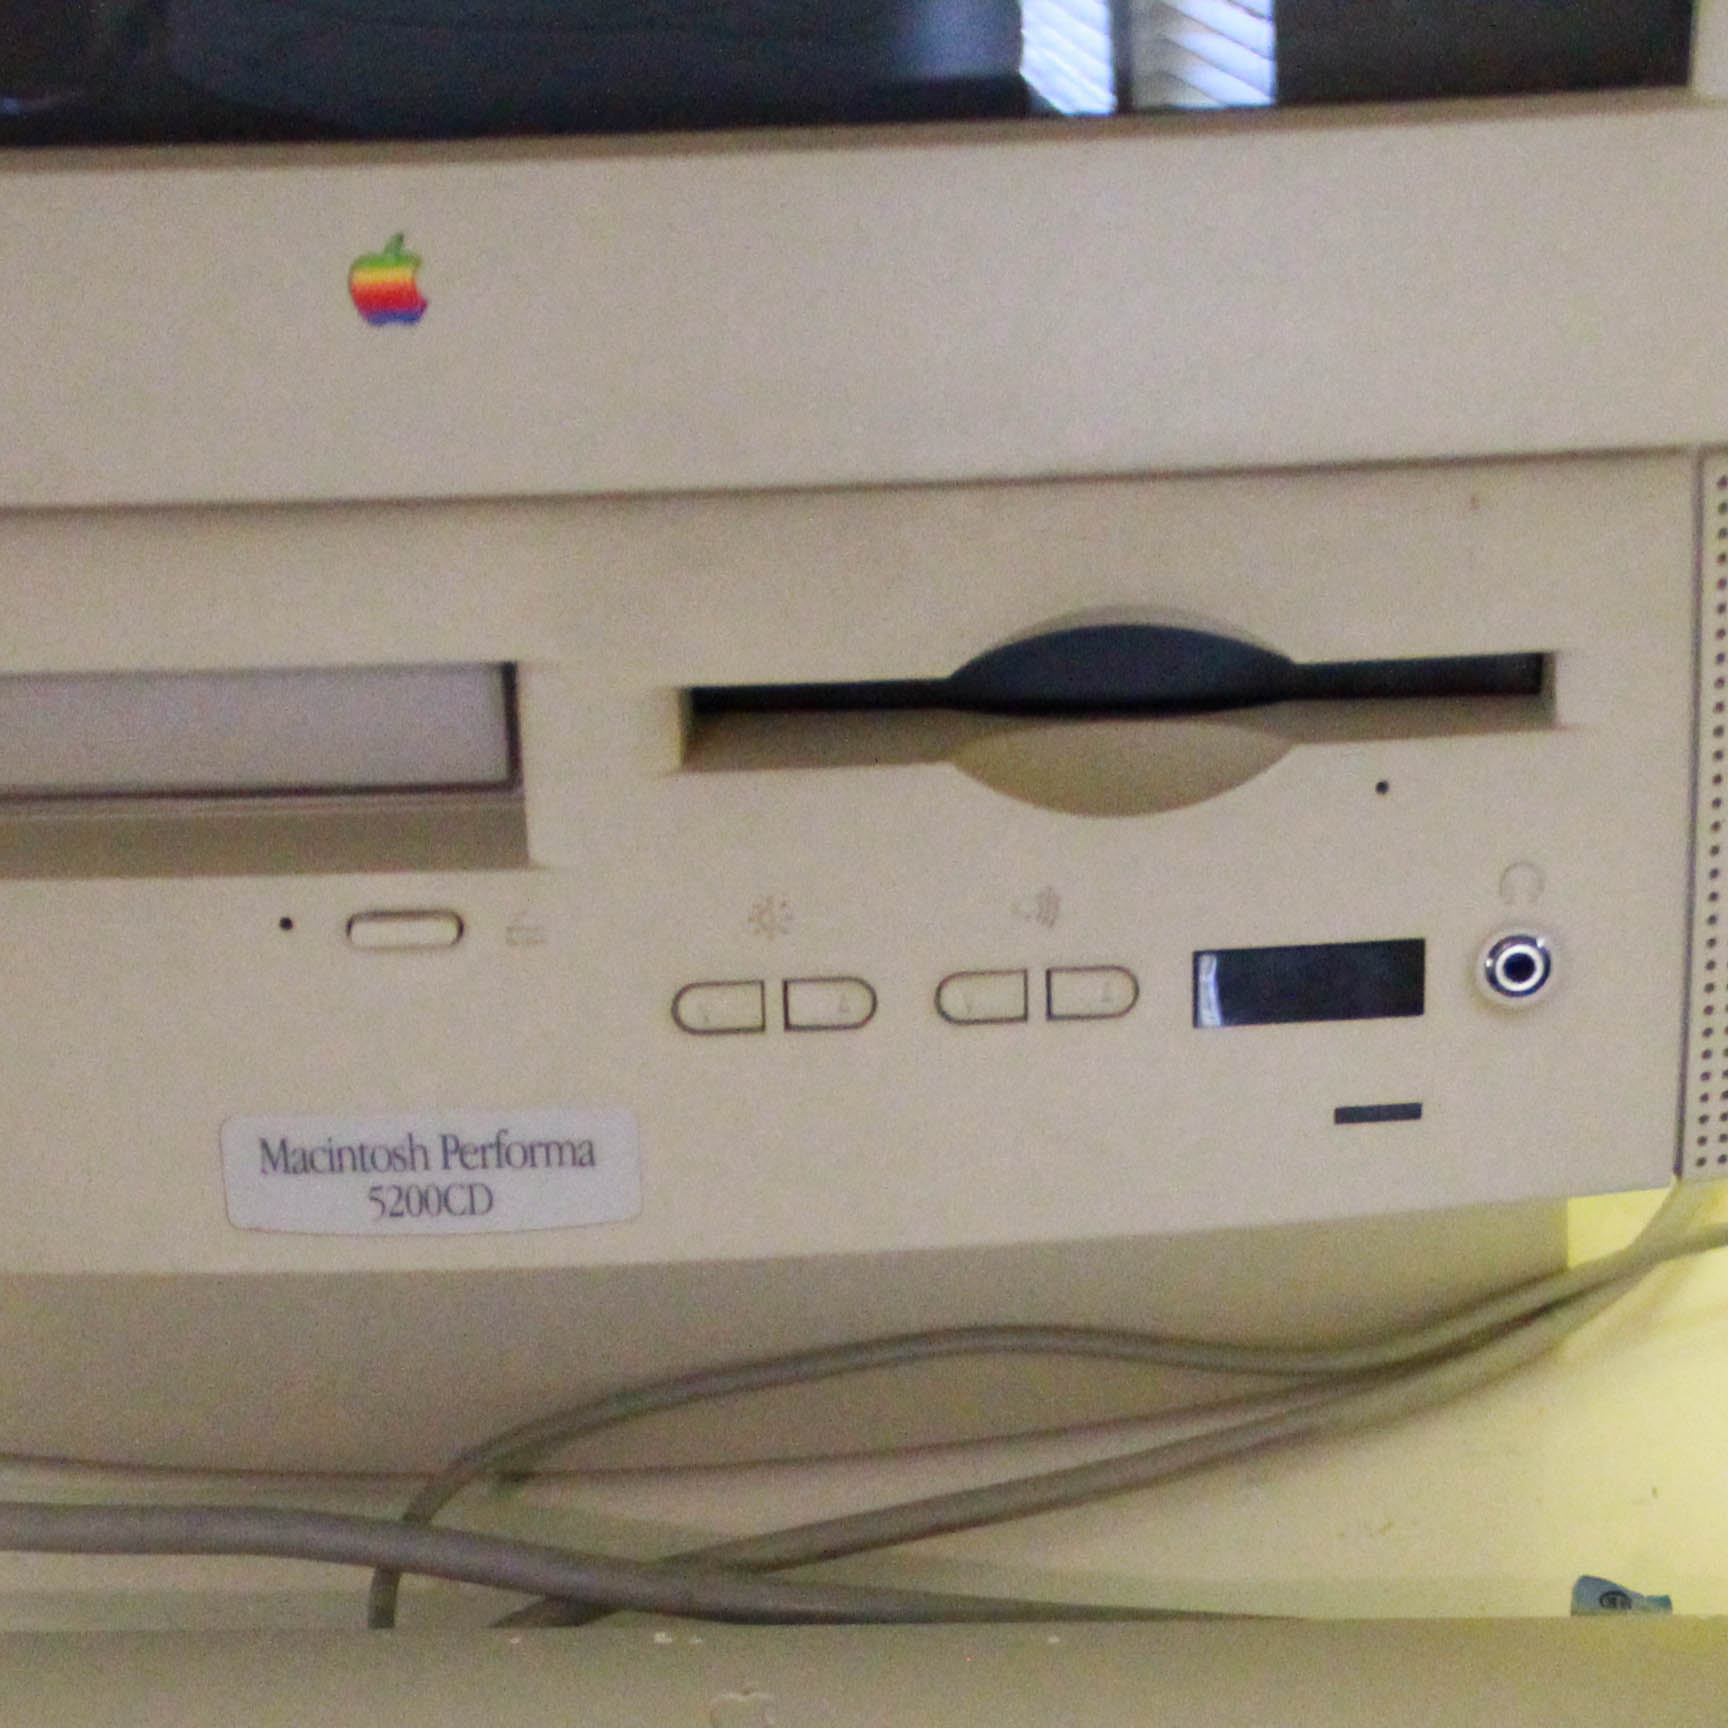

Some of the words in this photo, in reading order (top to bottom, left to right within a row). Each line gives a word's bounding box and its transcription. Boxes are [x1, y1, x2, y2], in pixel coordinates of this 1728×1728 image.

[258, 1132, 430, 1174] Macintosh
[437, 1130, 596, 1172] Performa
[368, 1182, 494, 1218] 5200CD
